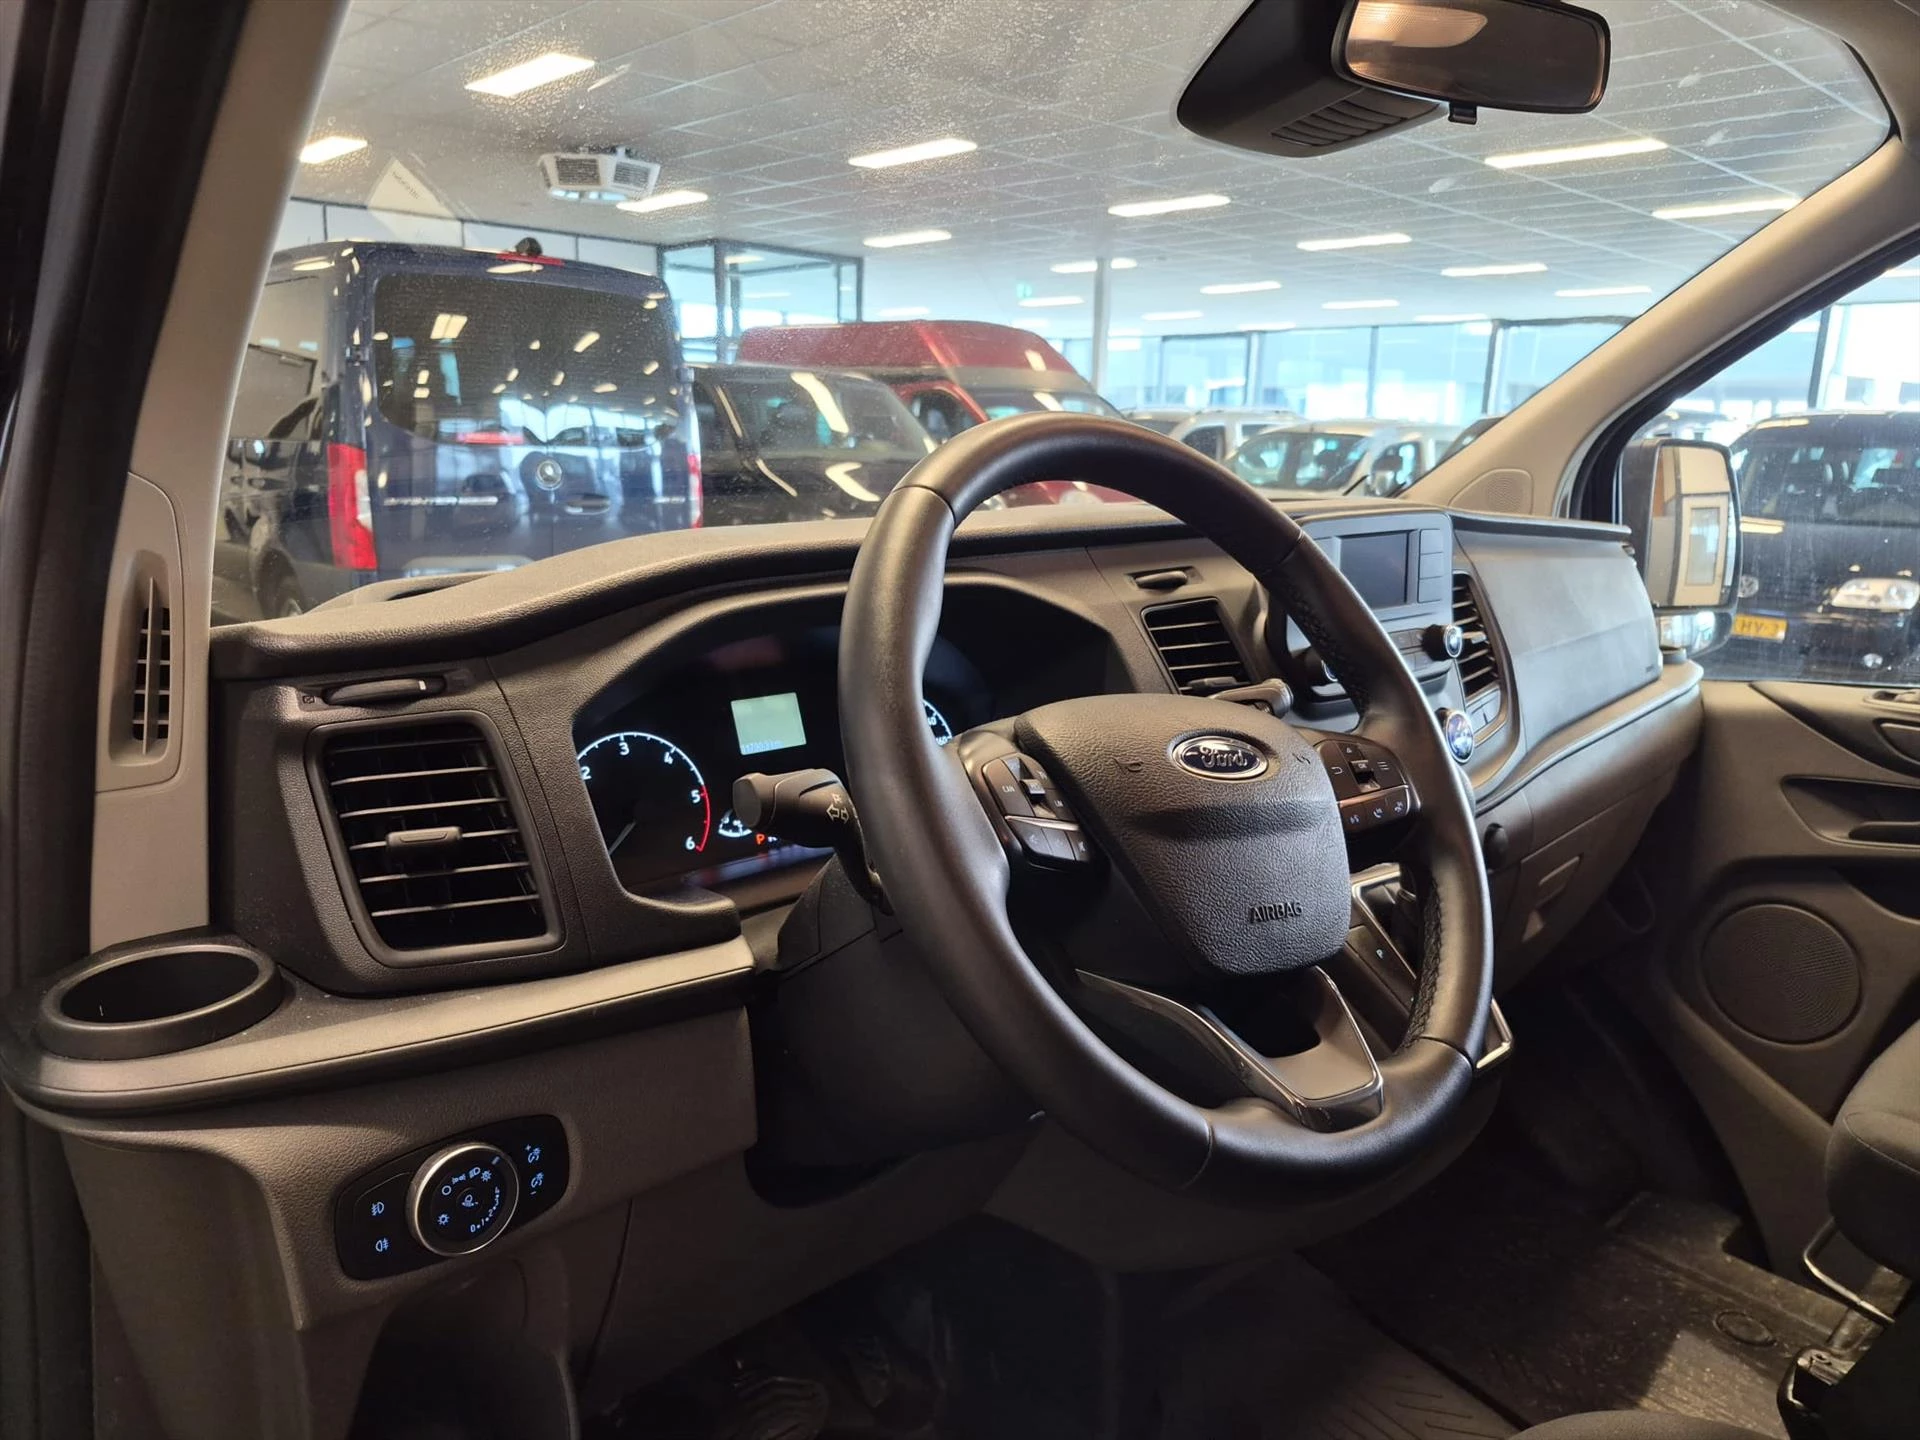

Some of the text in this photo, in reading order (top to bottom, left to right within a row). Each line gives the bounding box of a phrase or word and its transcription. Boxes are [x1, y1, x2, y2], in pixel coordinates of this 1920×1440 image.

[619, 742, 630, 756] 3
[664, 752, 674, 765] 4
[1200, 746, 1248, 768] Ford
[580, 766, 592, 780] 2
[691, 790, 701, 803] 5
[685, 836, 696, 850] 6
[756, 833, 765, 845] P
[1249, 902, 1303, 923] AIRBAG
[1376, 949, 1383, 959] P
